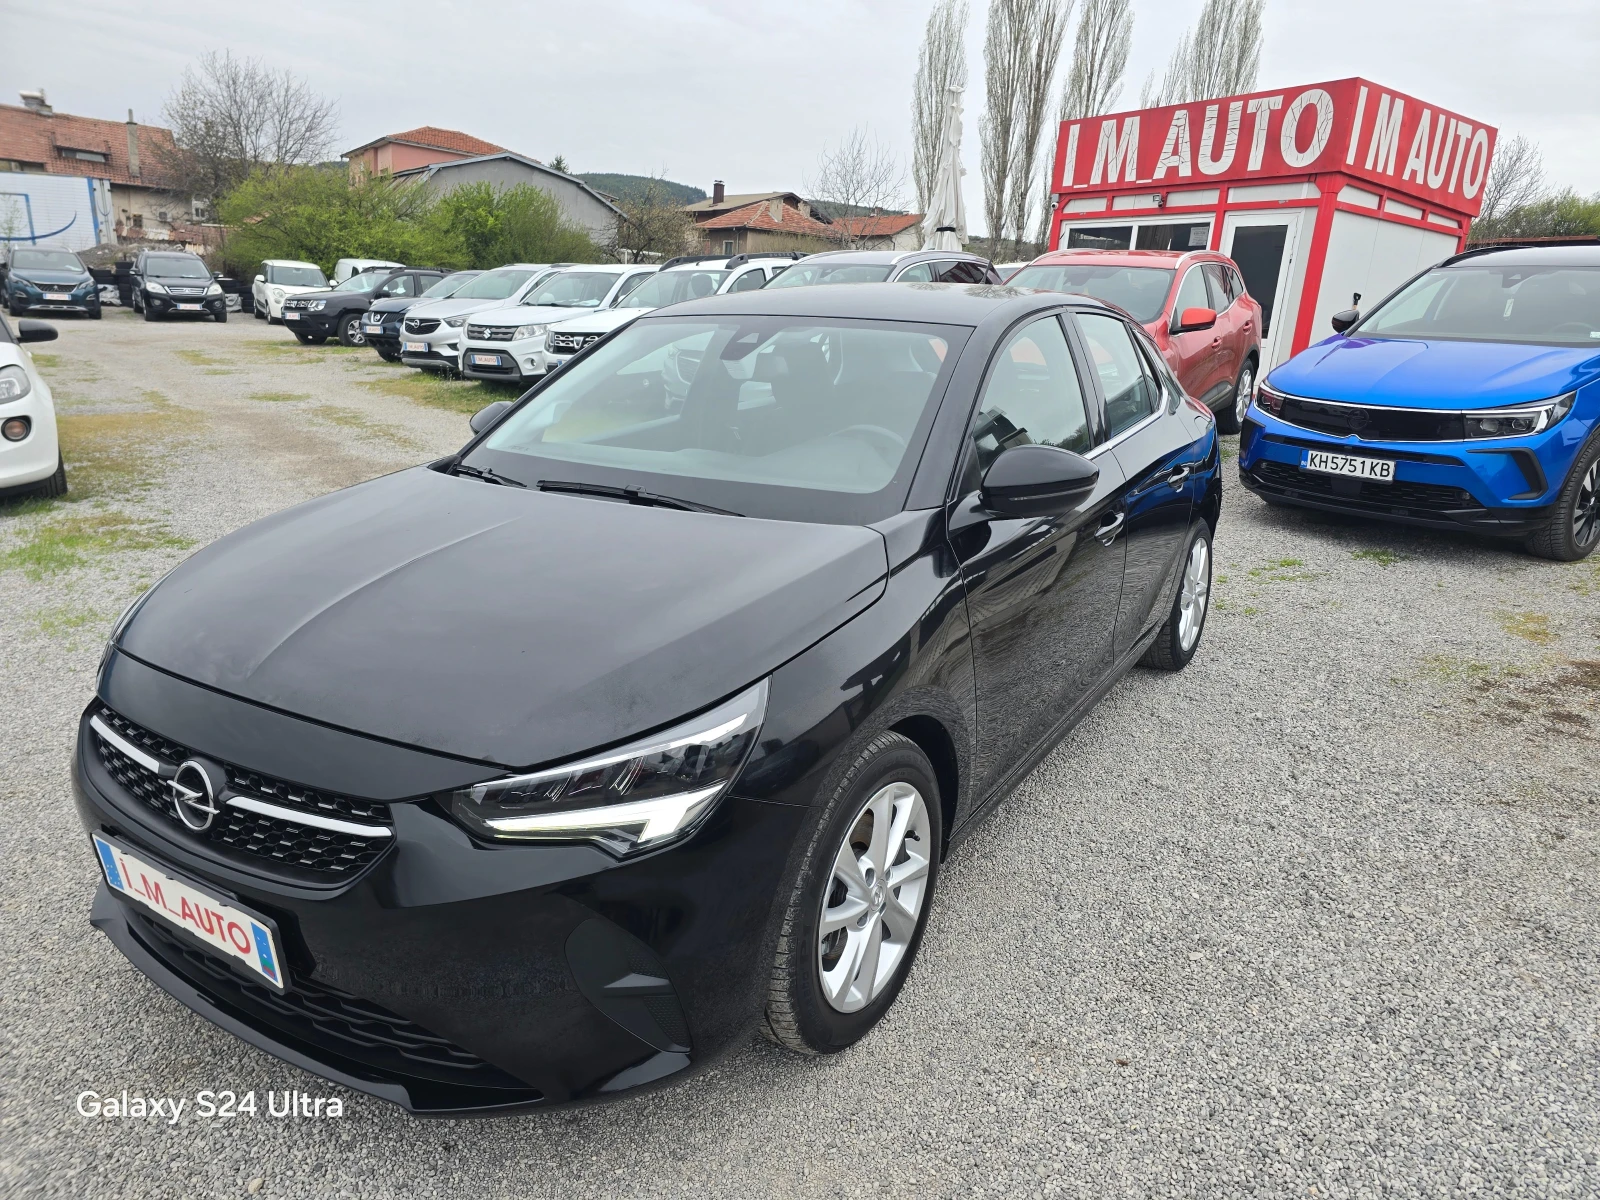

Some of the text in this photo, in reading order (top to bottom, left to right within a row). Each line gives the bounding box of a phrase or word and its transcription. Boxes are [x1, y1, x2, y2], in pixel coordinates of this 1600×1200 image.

[1345, 85, 1489, 200] I M AUTO
